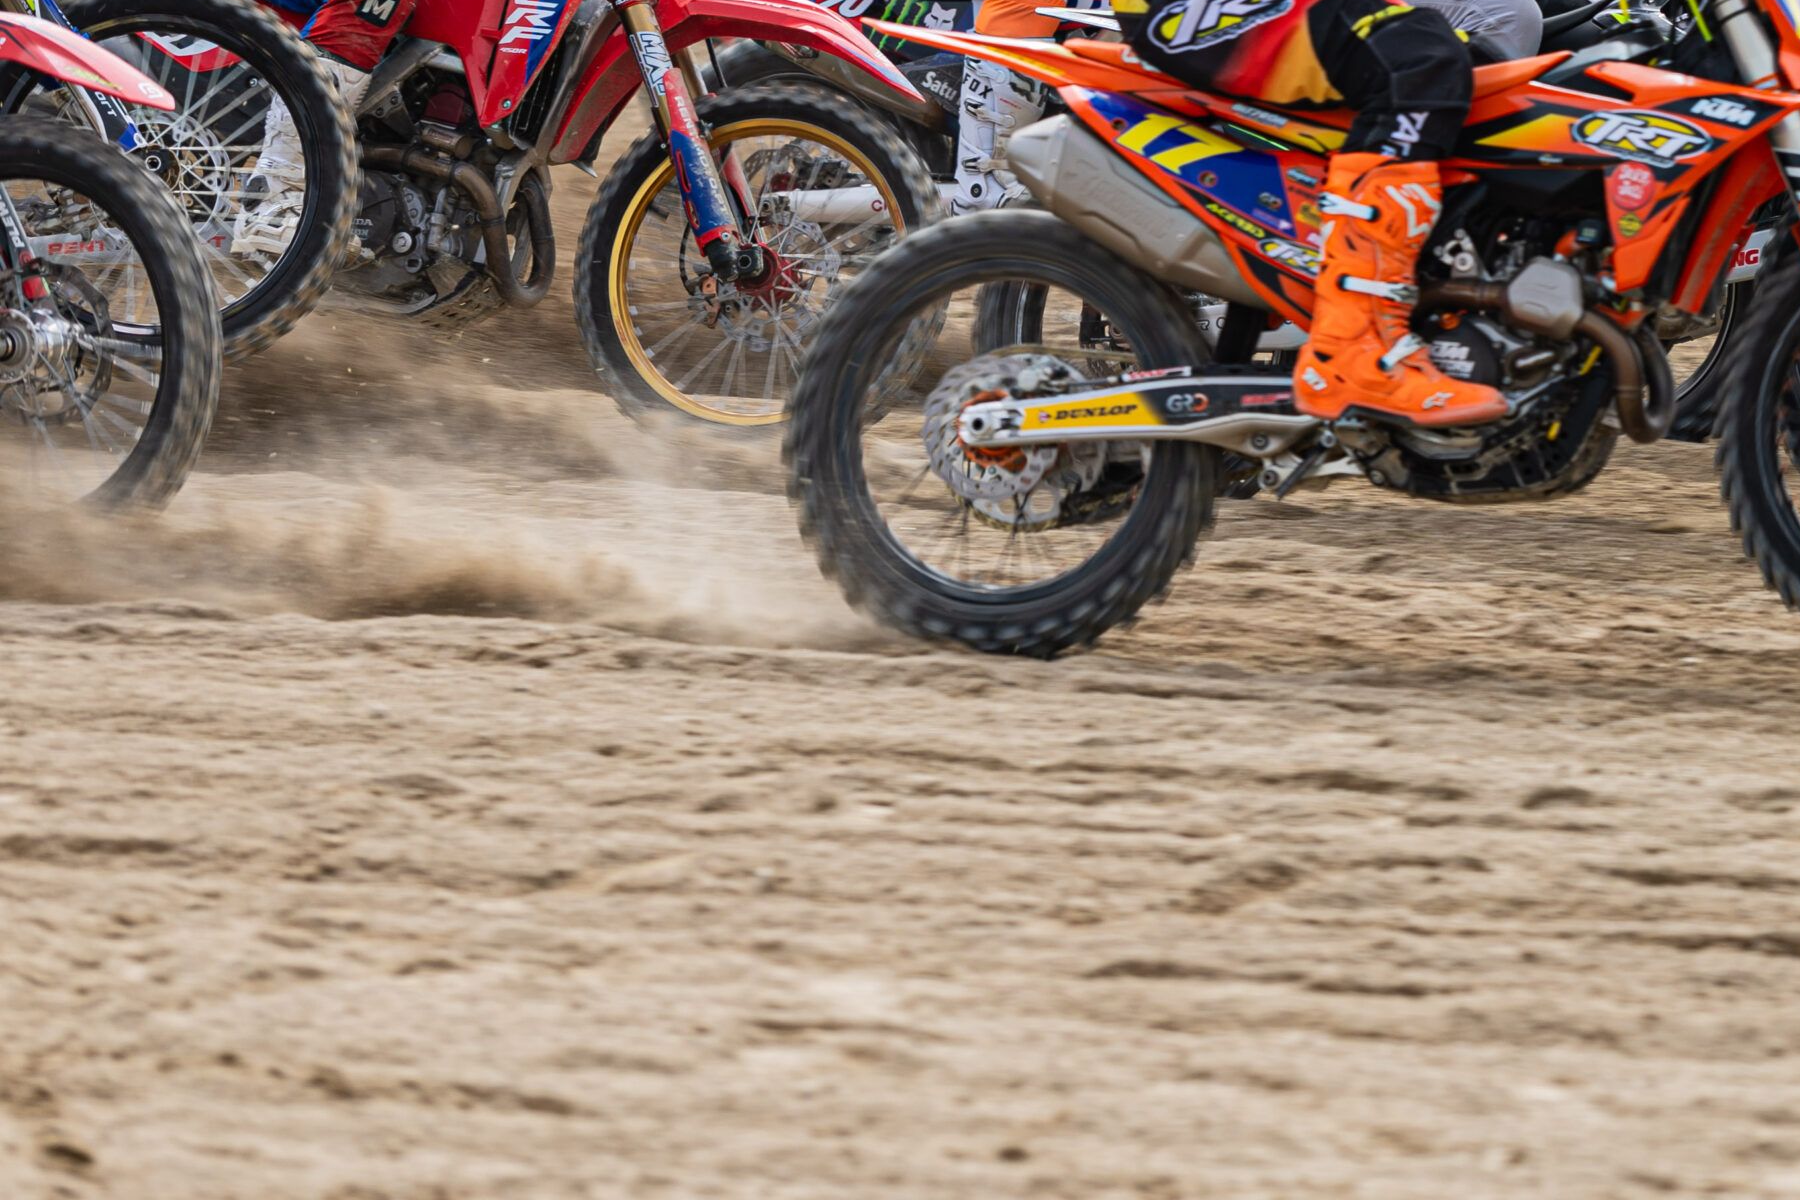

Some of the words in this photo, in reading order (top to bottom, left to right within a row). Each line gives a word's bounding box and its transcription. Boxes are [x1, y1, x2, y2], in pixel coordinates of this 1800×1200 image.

[961, 74, 994, 100] FOX
[1689, 97, 1757, 126] KTM
[1585, 112, 1705, 157] TRT
[1053, 404, 1139, 421] DUNLOP
